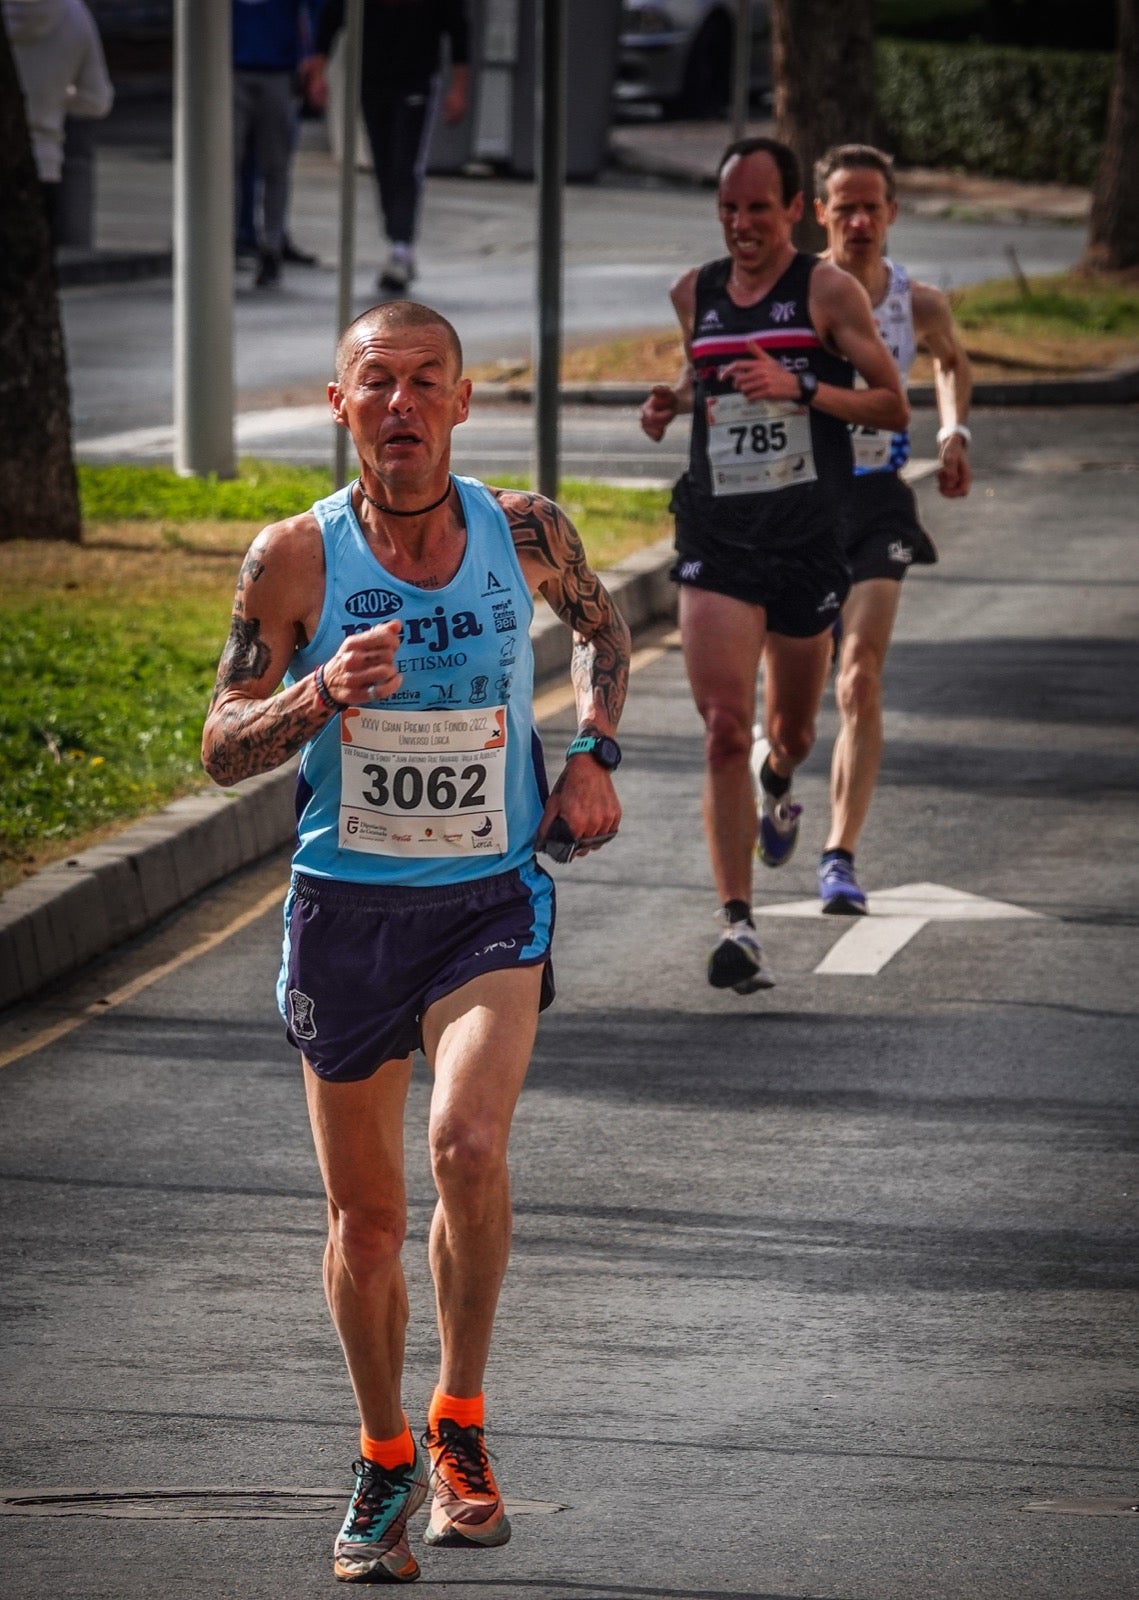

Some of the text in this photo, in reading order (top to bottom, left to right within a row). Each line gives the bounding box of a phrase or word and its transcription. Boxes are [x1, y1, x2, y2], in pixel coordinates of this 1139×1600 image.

[729, 421, 788, 456] 785
[347, 590, 401, 614] TROPS
[341, 605, 483, 652] nrja
[397, 652, 467, 674] ETISMO
[404, 721, 431, 734] PREMIO
[469, 717, 488, 731] 2022
[362, 763, 487, 810] 3062
